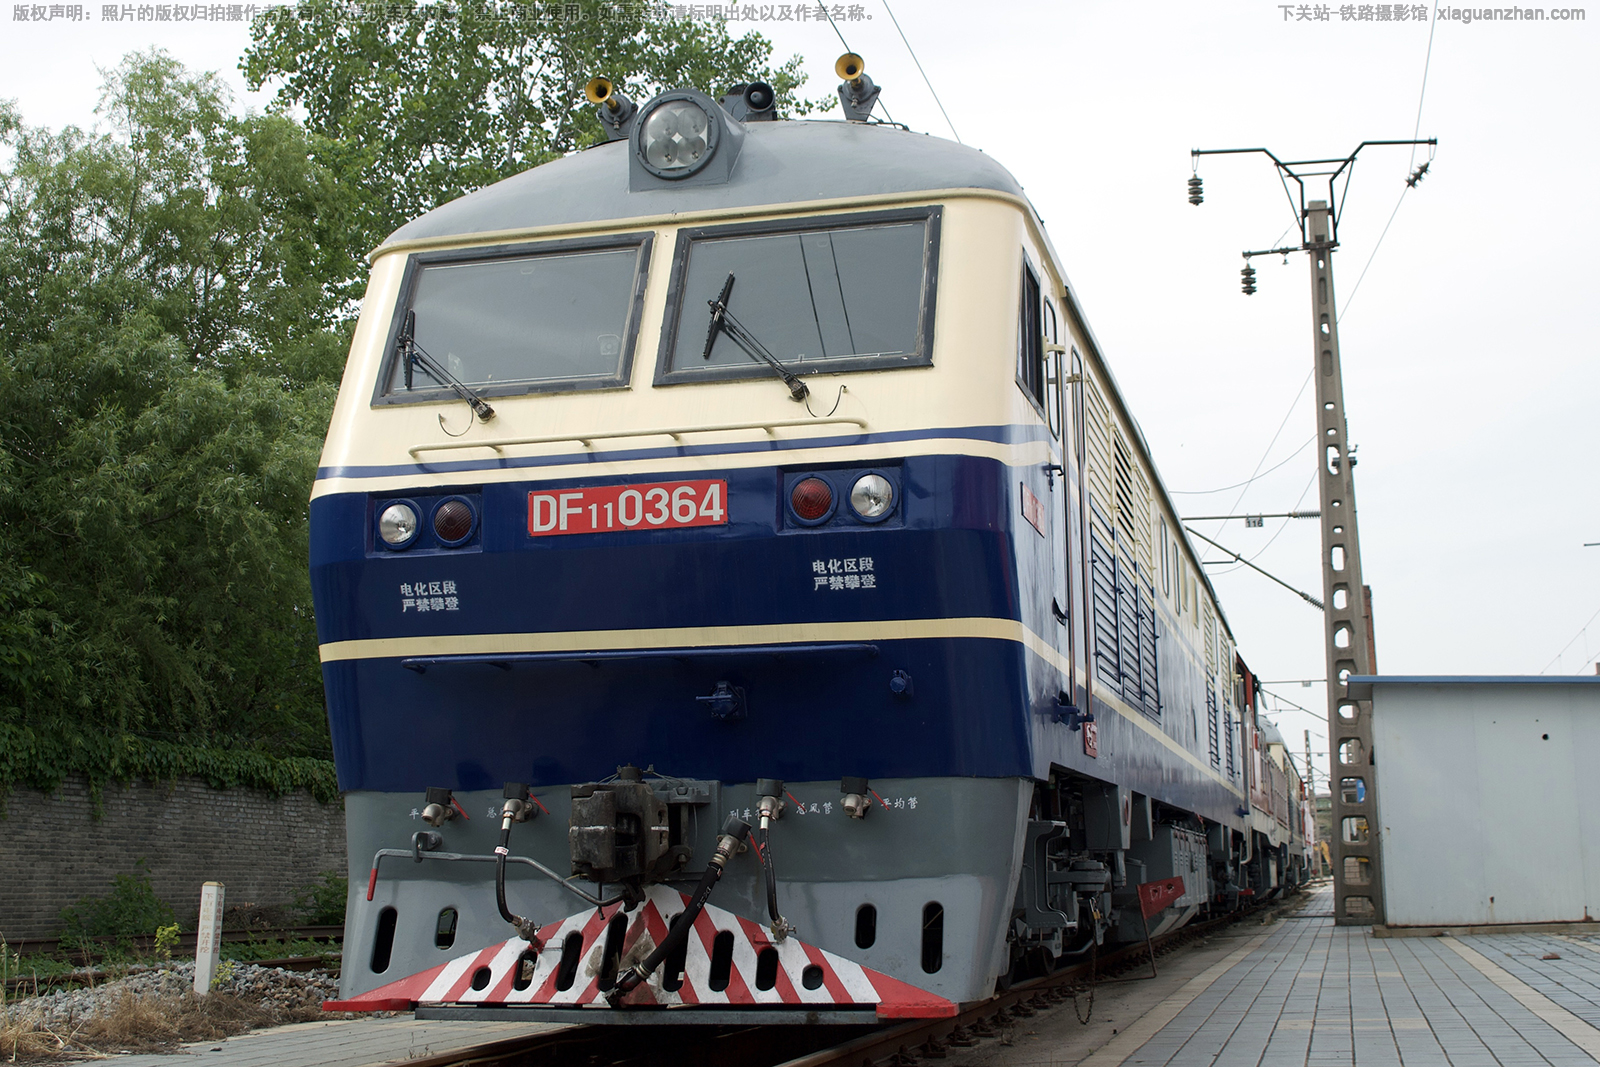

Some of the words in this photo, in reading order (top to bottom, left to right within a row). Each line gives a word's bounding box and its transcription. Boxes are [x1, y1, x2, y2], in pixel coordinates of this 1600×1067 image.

[533, 483, 724, 532] DF110364
[812, 557, 874, 574] 电化区段
[400, 581, 457, 596] 电化区段
[813, 574, 876, 591] 严禁攀登
[402, 597, 459, 613] 严禁攀登
